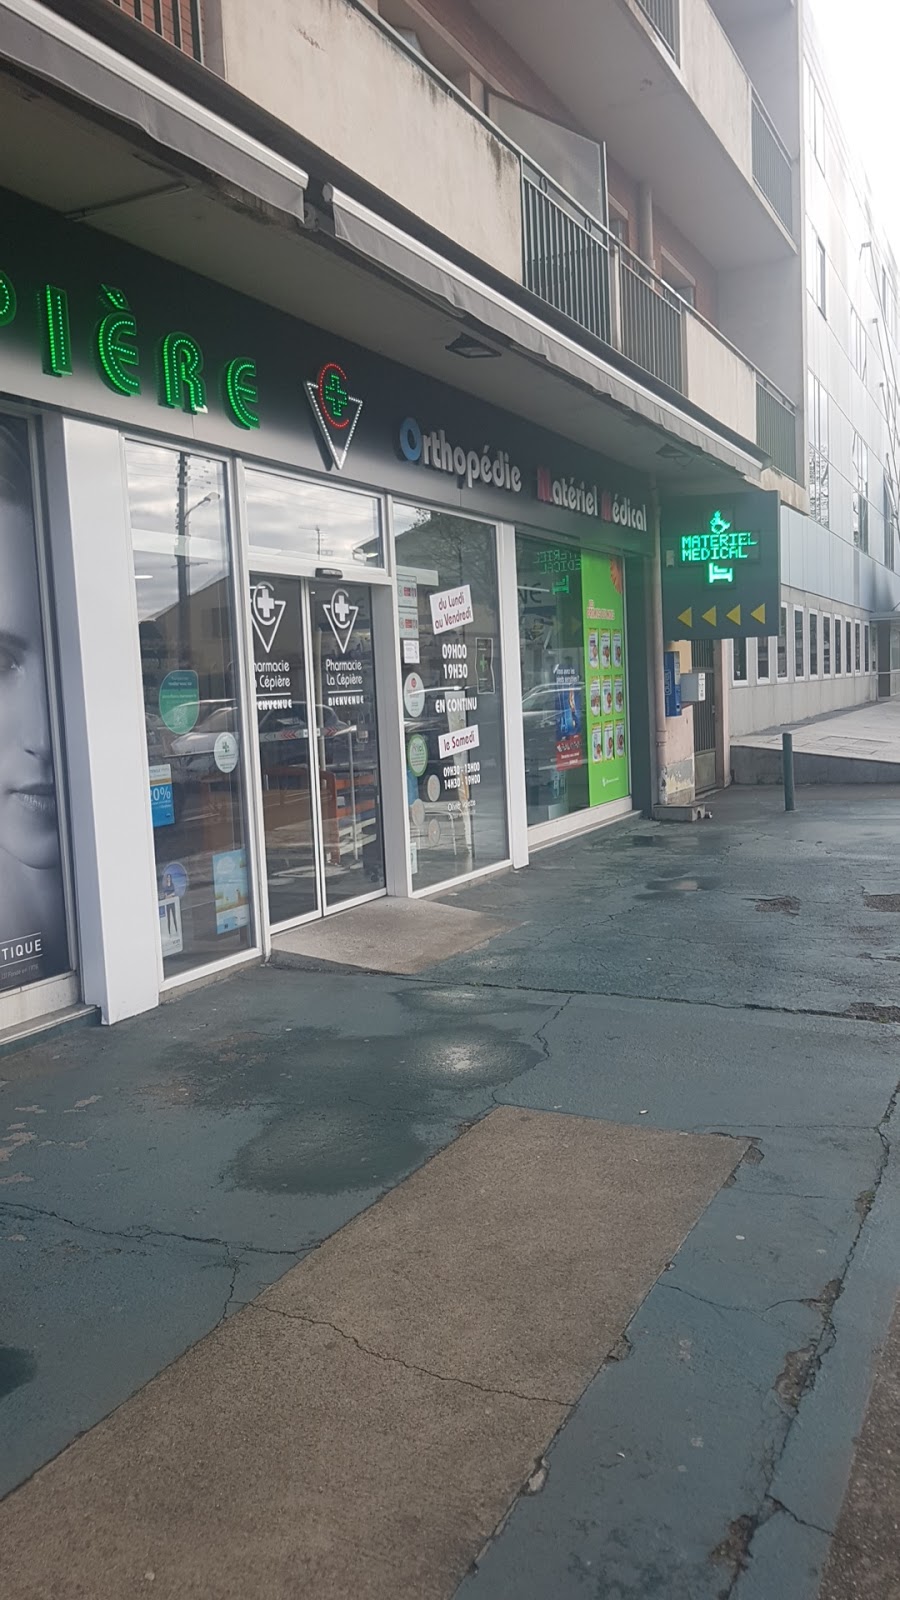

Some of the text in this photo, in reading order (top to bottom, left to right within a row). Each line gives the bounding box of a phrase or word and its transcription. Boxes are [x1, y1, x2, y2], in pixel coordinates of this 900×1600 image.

[400, 417, 521, 492] Orthopédie
[537, 466, 647, 532] Matériel Médical
[681, 531, 757, 549] MATERIEL
[681, 546, 748, 561] MEDICAL
[438, 591, 465, 611] du Lundi
[434, 618, 444, 629] au
[443, 606, 472, 626] Vendredi
[442, 644, 467, 659] 09H00
[326, 658, 362, 672] Pharmacie
[443, 664, 468, 679] 19H30
[259, 674, 291, 691] Cépière
[336, 673, 363, 689] Cépière
[328, 695, 364, 707] BIENVENUE
[435, 700, 446, 713] EN
[446, 697, 477, 712] CONTINU
[451, 730, 476, 749] Samedi
[1, 938, 42, 961] TIQUE
